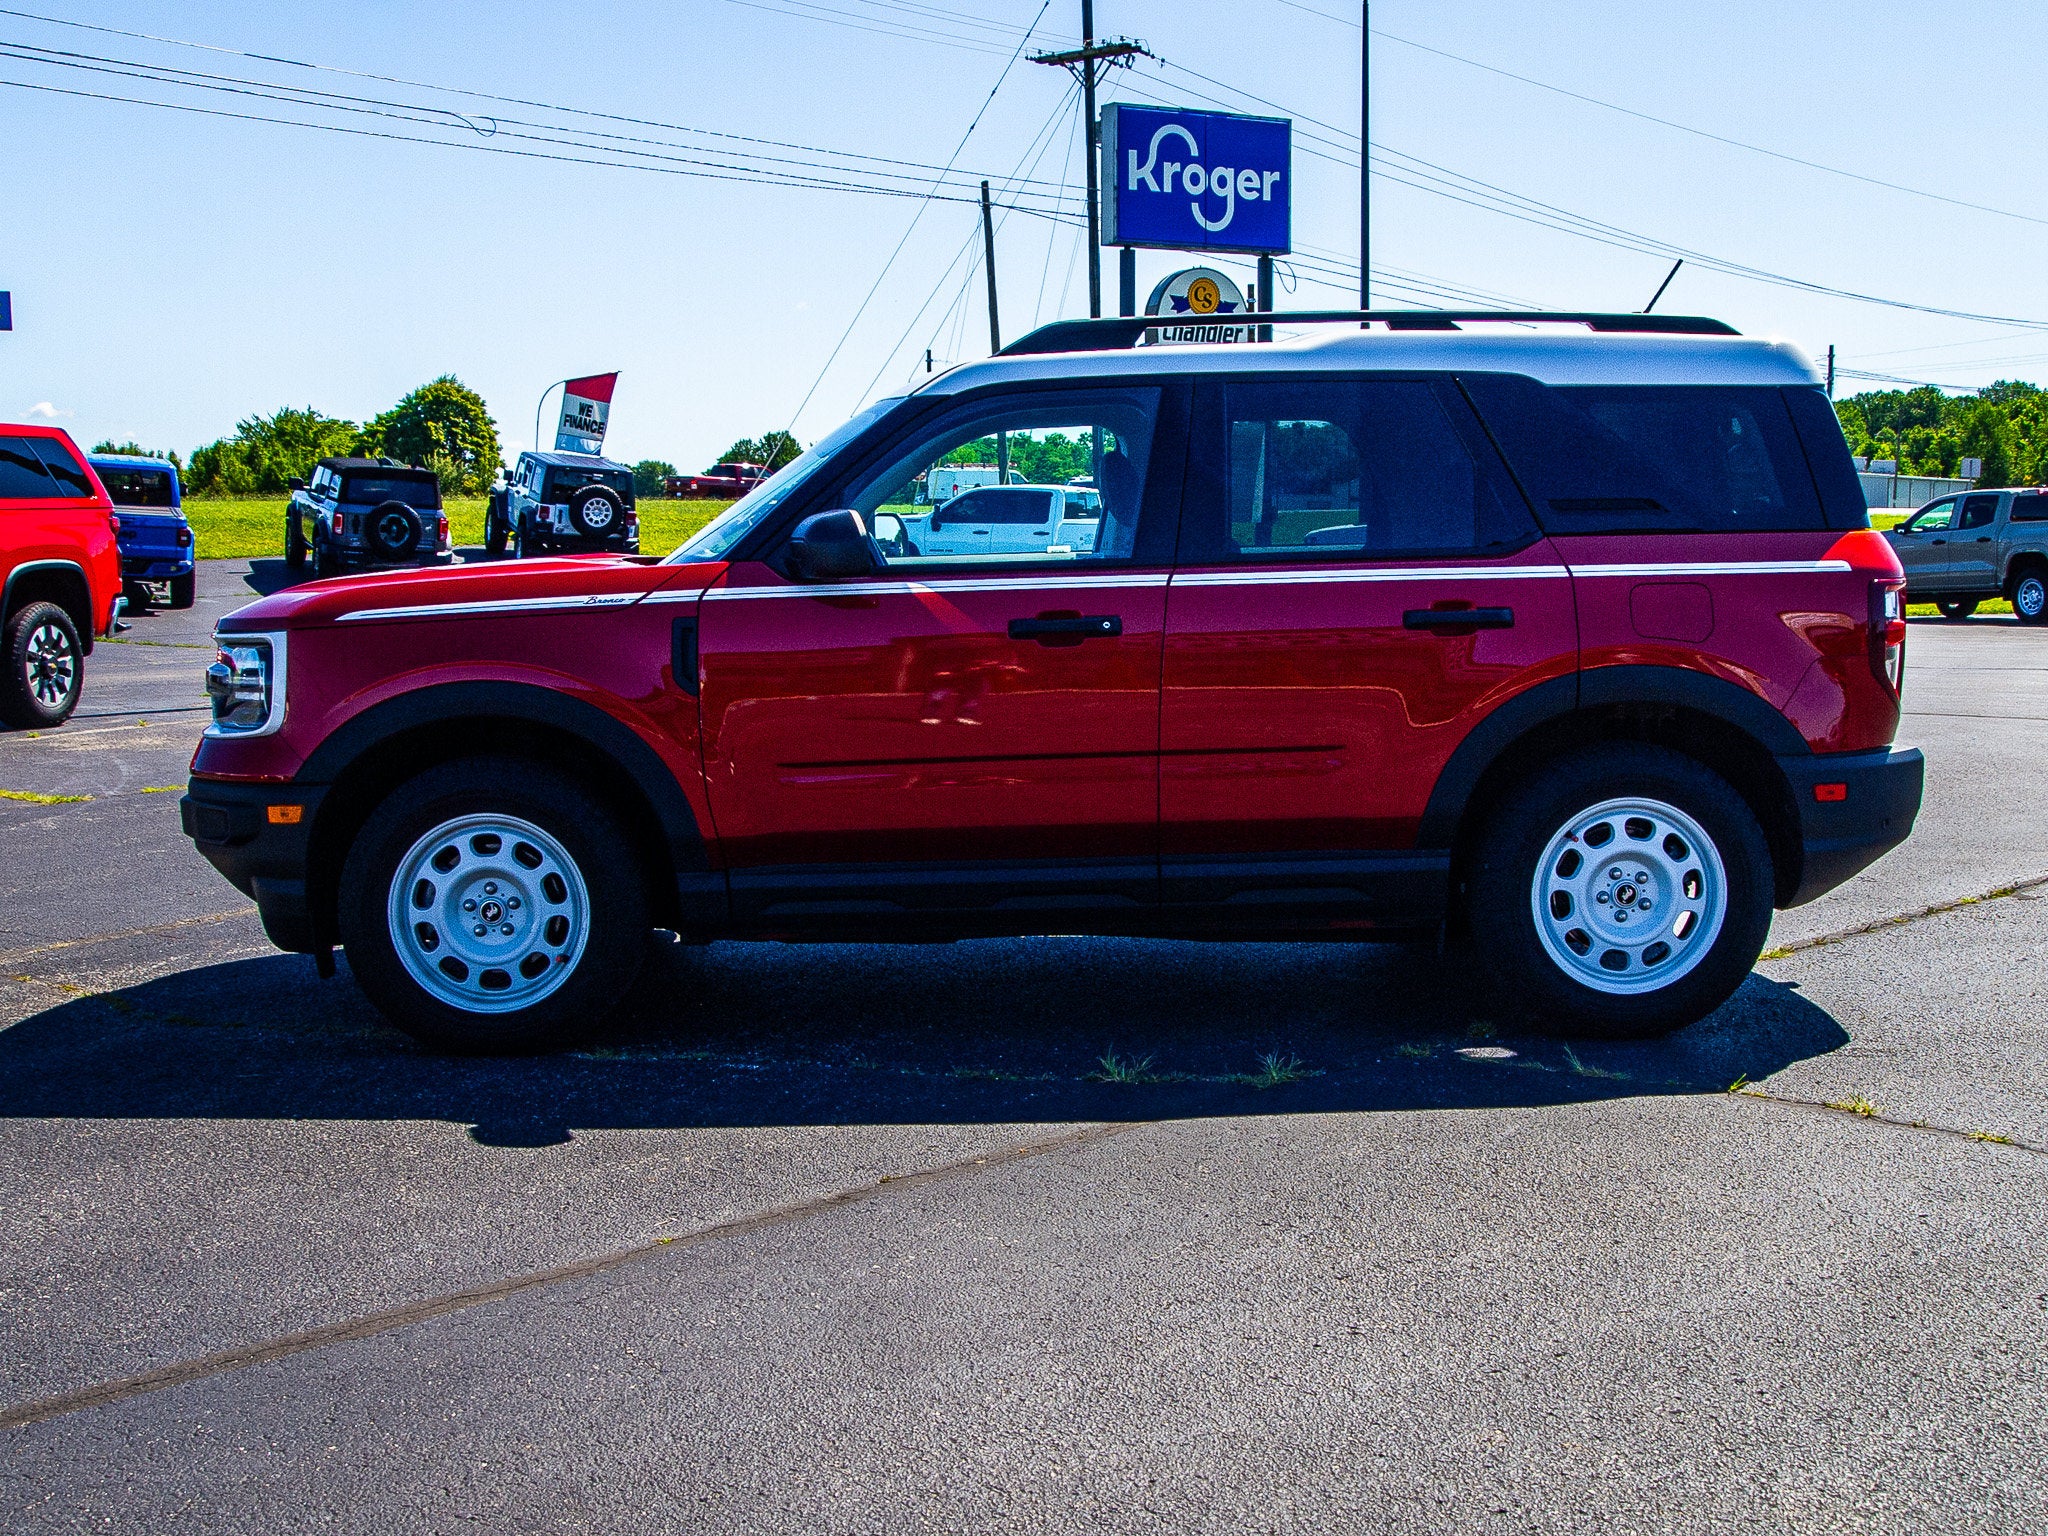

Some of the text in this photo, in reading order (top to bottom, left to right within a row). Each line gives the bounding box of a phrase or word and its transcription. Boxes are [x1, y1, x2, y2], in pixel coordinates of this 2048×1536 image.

[1128, 124, 1280, 231] Kroger
[579, 402, 593, 418] WE
[564, 414, 605, 434] FINANCE
[583, 596, 626, 605] Bronco
